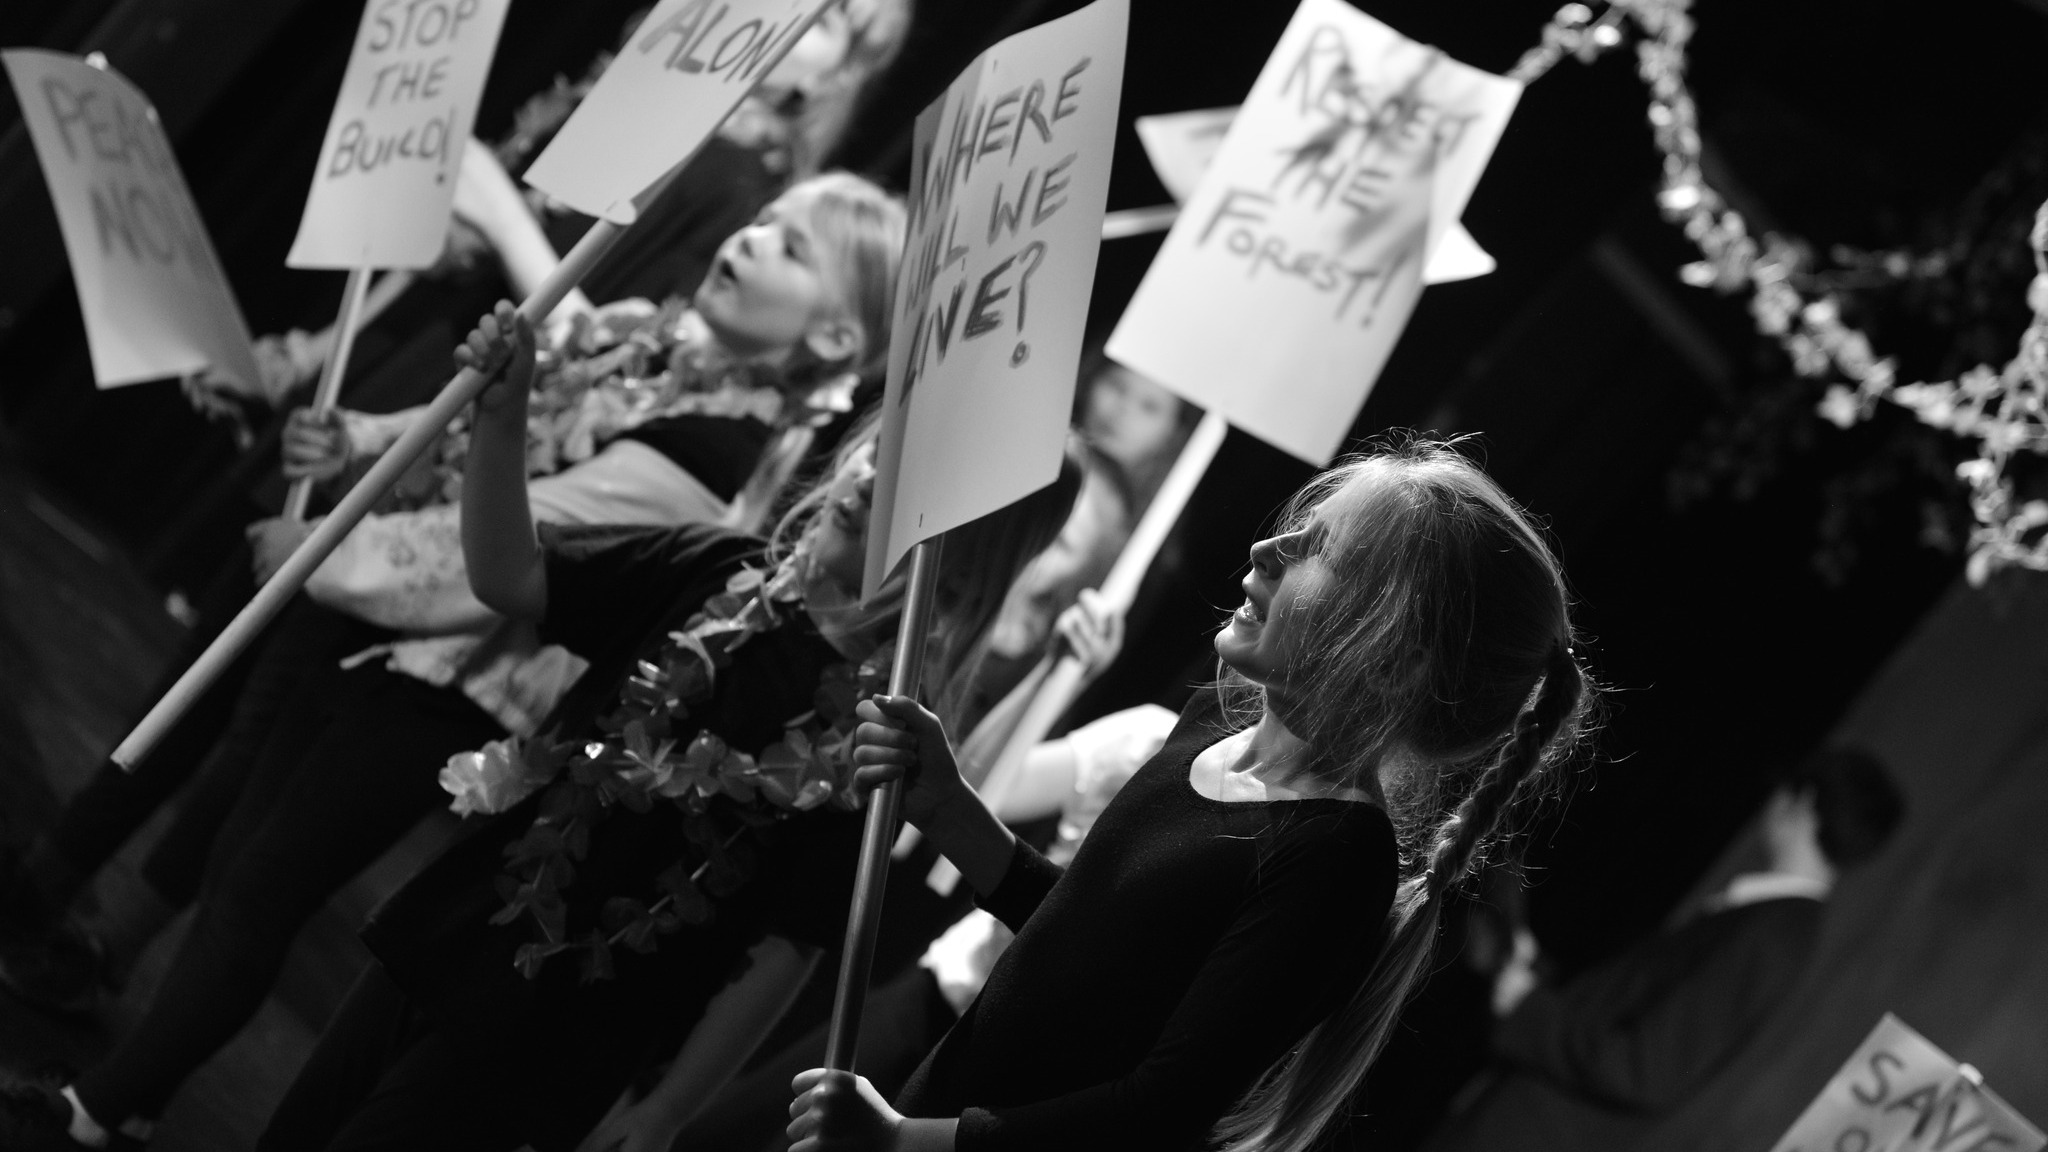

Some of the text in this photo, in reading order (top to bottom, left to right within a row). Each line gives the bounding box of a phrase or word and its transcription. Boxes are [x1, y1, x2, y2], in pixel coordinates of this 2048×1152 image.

[369, 0, 479, 53] STOP
[638, 0, 803, 83] ALON
[366, 55, 453, 110] THE
[40, 74, 170, 175] PEA
[327, 105, 457, 186] BUILD!
[916, 55, 1093, 236] WHERE
[1270, 145, 1392, 214] THE
[902, 150, 1079, 318] WILL WE
[898, 240, 1049, 408] LIVE?
